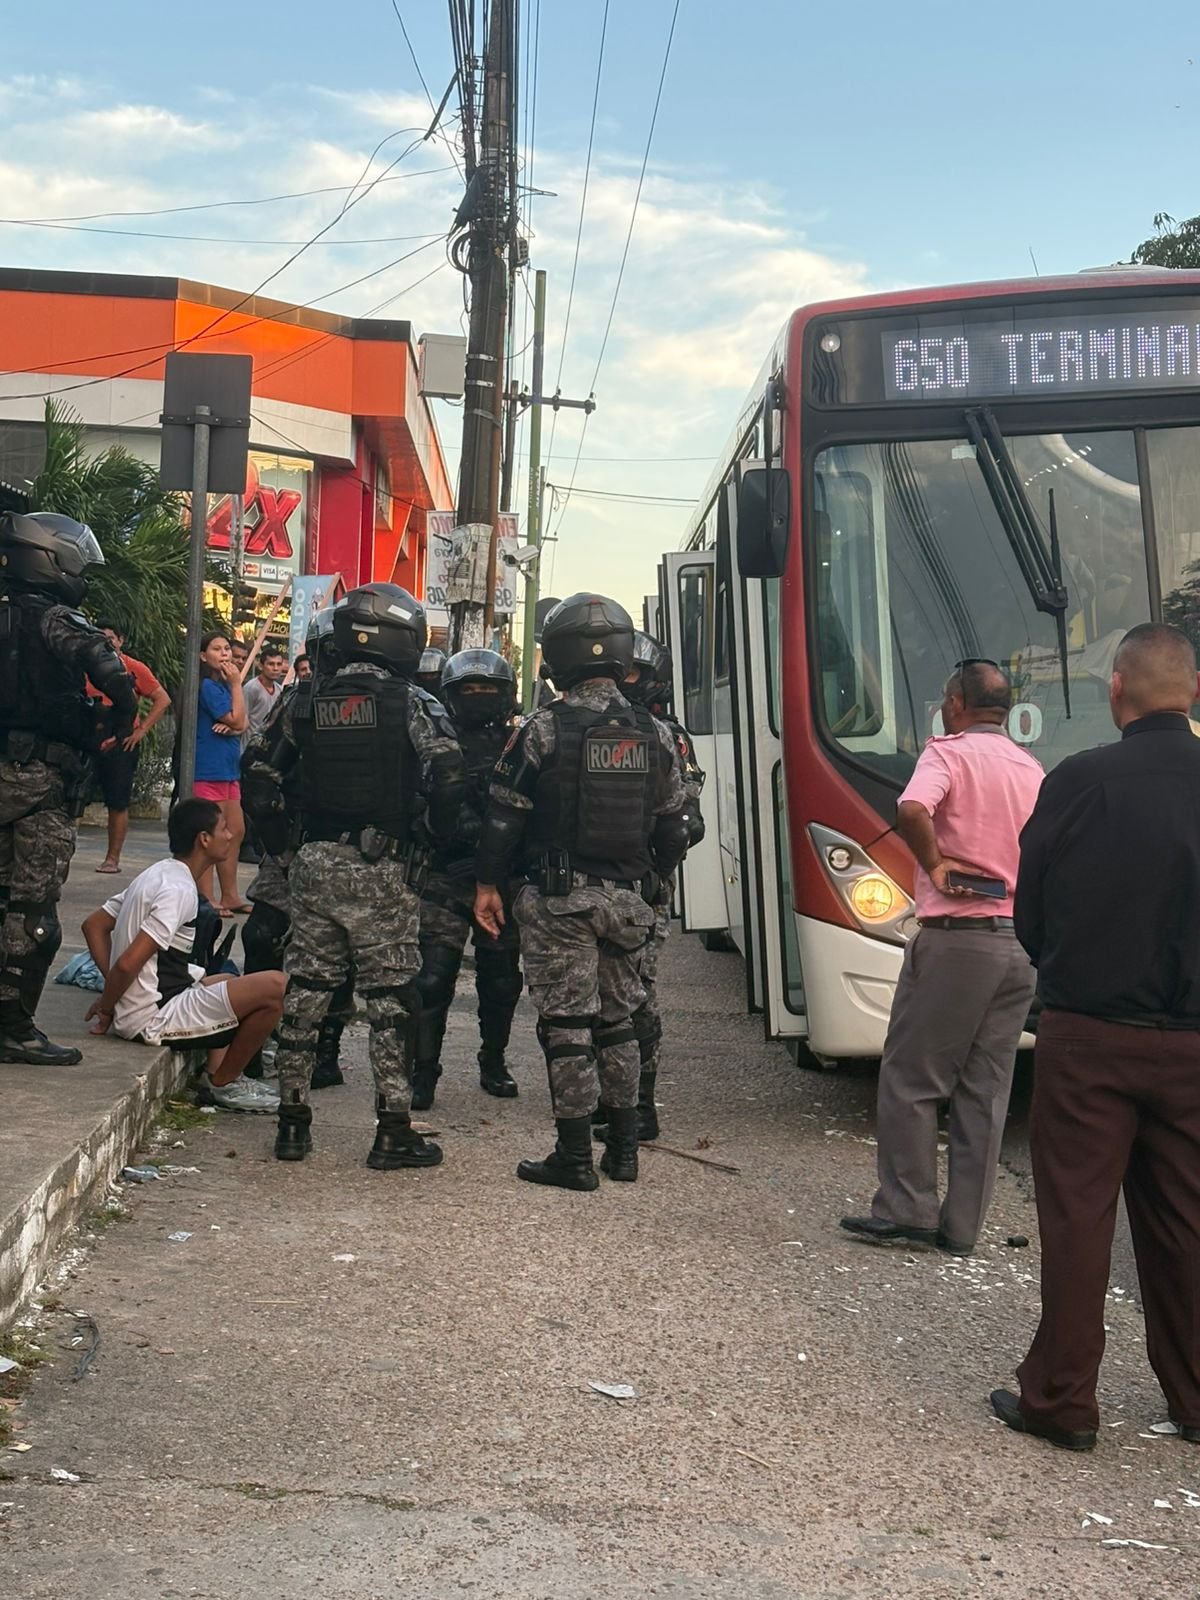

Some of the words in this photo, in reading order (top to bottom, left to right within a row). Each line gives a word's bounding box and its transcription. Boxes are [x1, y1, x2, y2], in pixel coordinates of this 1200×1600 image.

[894, 337, 969, 391] 650
[1001, 324, 1200, 385] TERMINA
[263, 567, 275, 575] VISA
[318, 700, 373, 725] ROCAM
[590, 743, 645, 768] ROCAM
